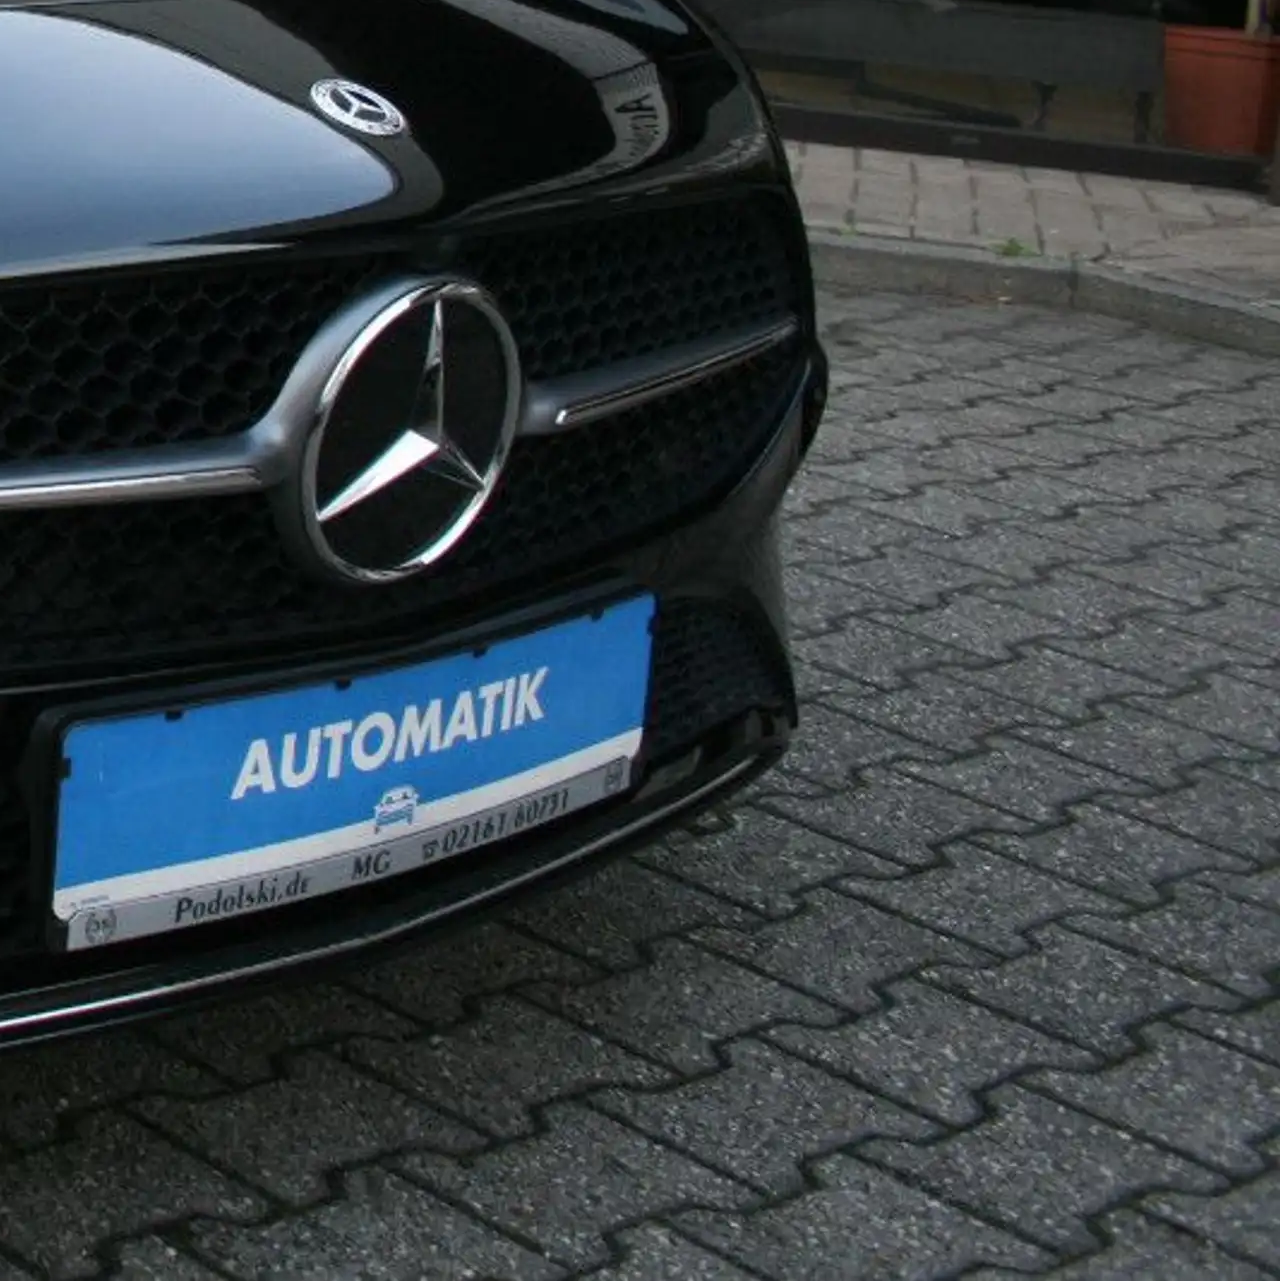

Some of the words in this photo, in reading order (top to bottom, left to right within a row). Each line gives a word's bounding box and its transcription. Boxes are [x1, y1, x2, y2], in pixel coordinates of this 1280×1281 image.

[231, 667, 548, 800] AUTOMATIK
[175, 871, 311, 923] Podolski.de
[351, 850, 392, 880] MG
